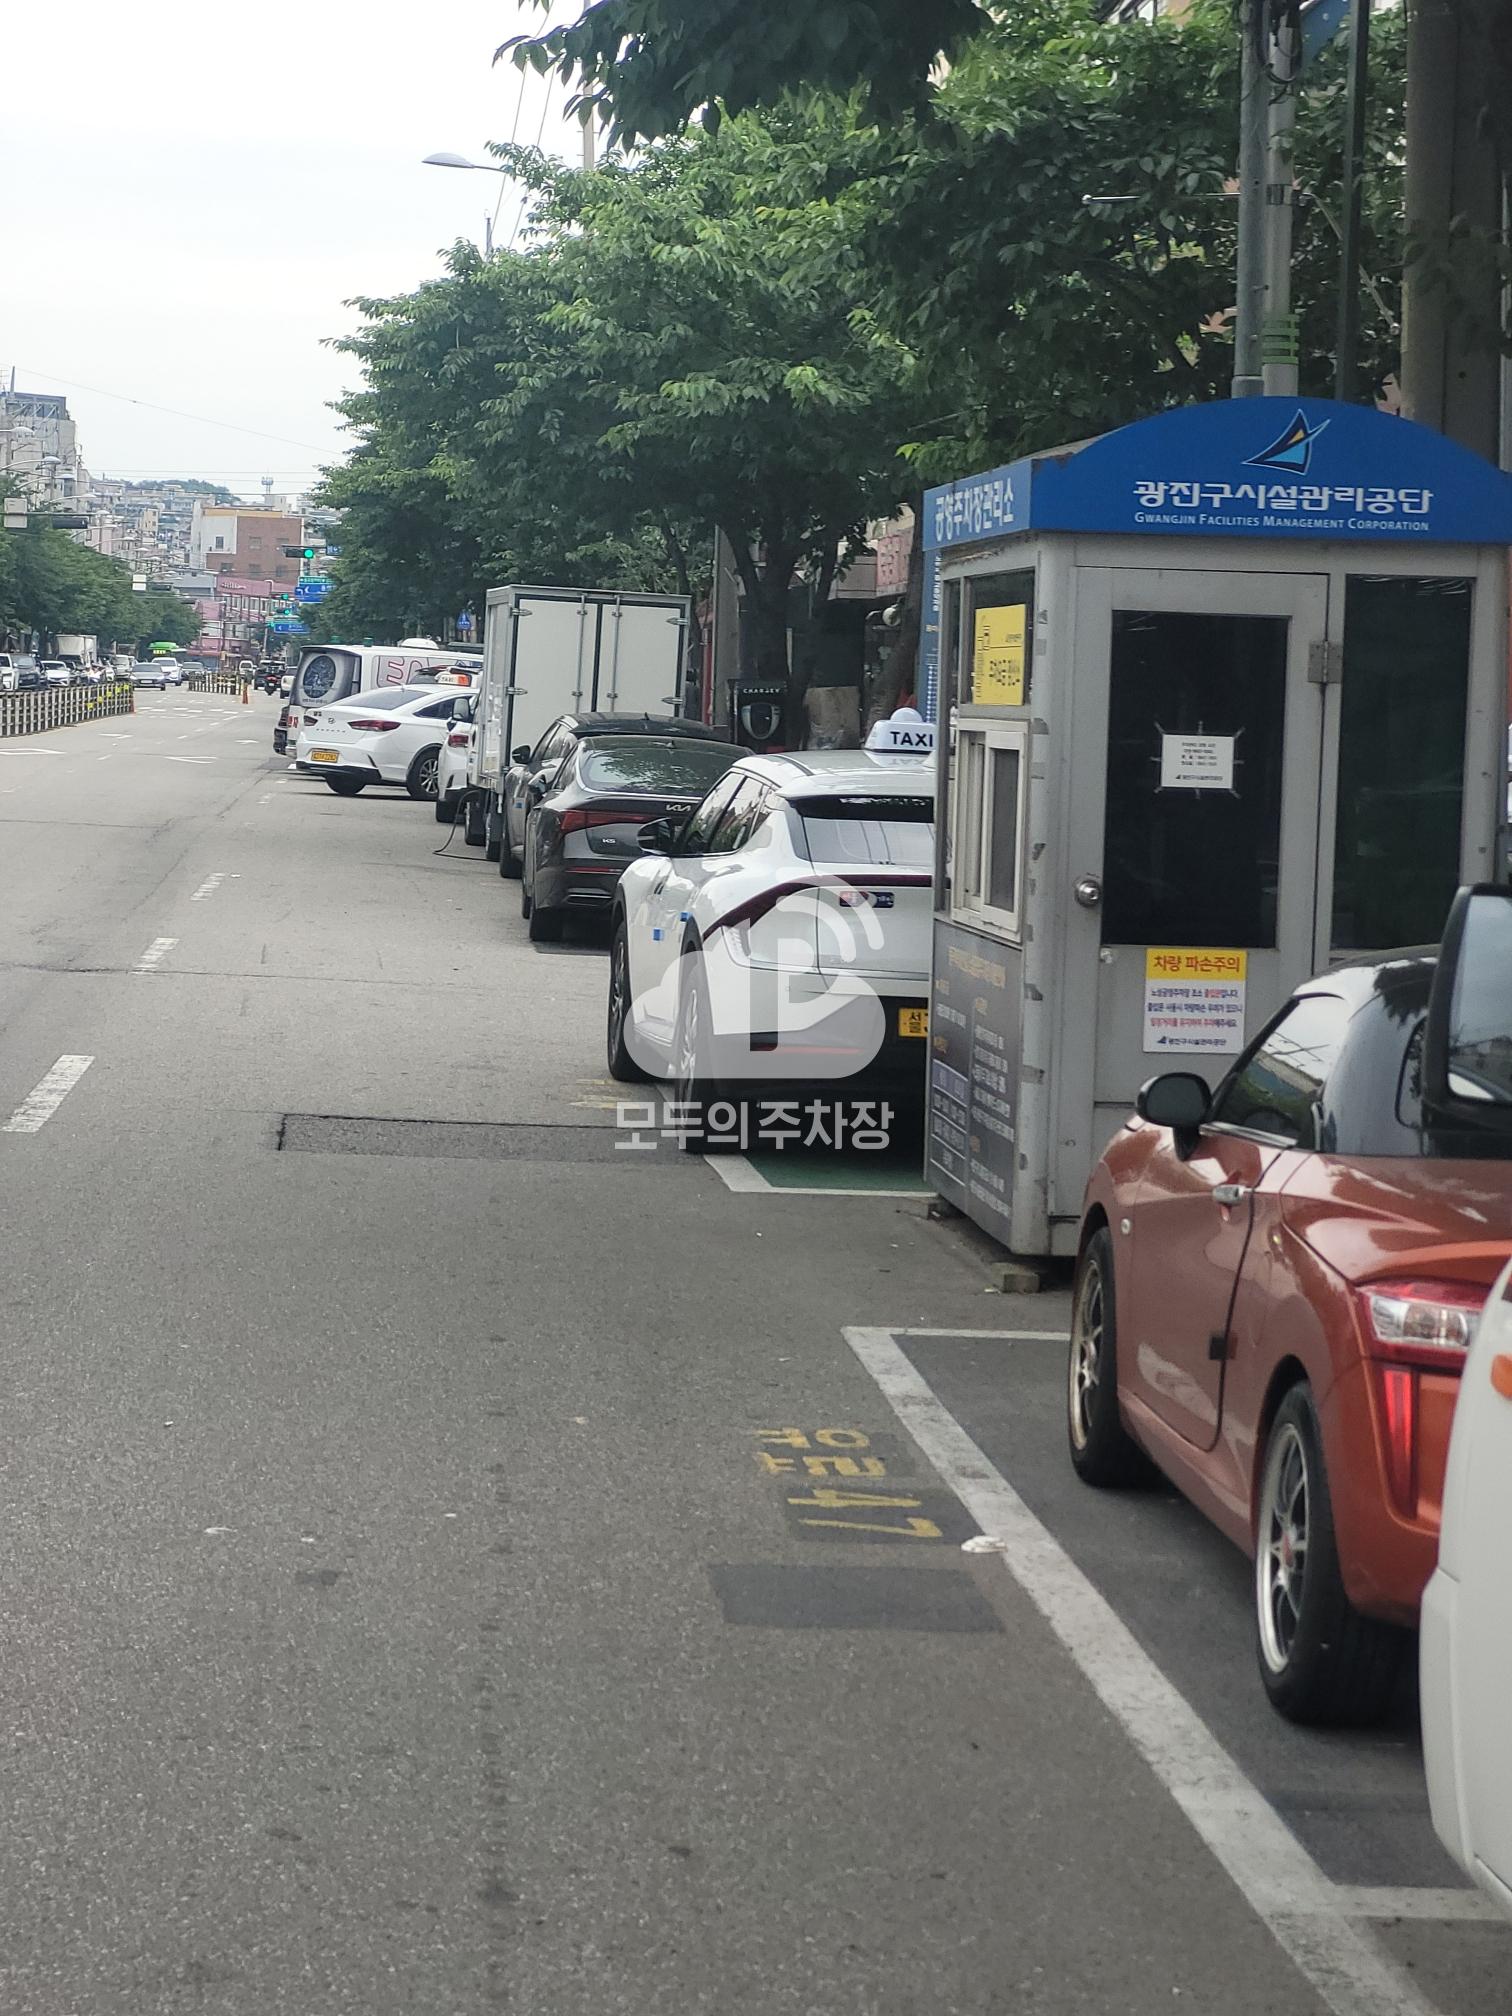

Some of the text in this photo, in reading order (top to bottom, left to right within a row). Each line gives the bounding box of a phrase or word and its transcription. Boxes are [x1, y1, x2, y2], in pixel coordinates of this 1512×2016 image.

[1132, 480, 1434, 514] 광진구시설관리공단
[935, 477, 1014, 542] 공영주차장관리소
[1134, 511, 1430, 532] GWANGJIN FACILITIES MANAGEMENT CORPORATION
[889, 731, 934, 747] TAXI
[1153, 955, 1240, 972] 차량 파손주의
